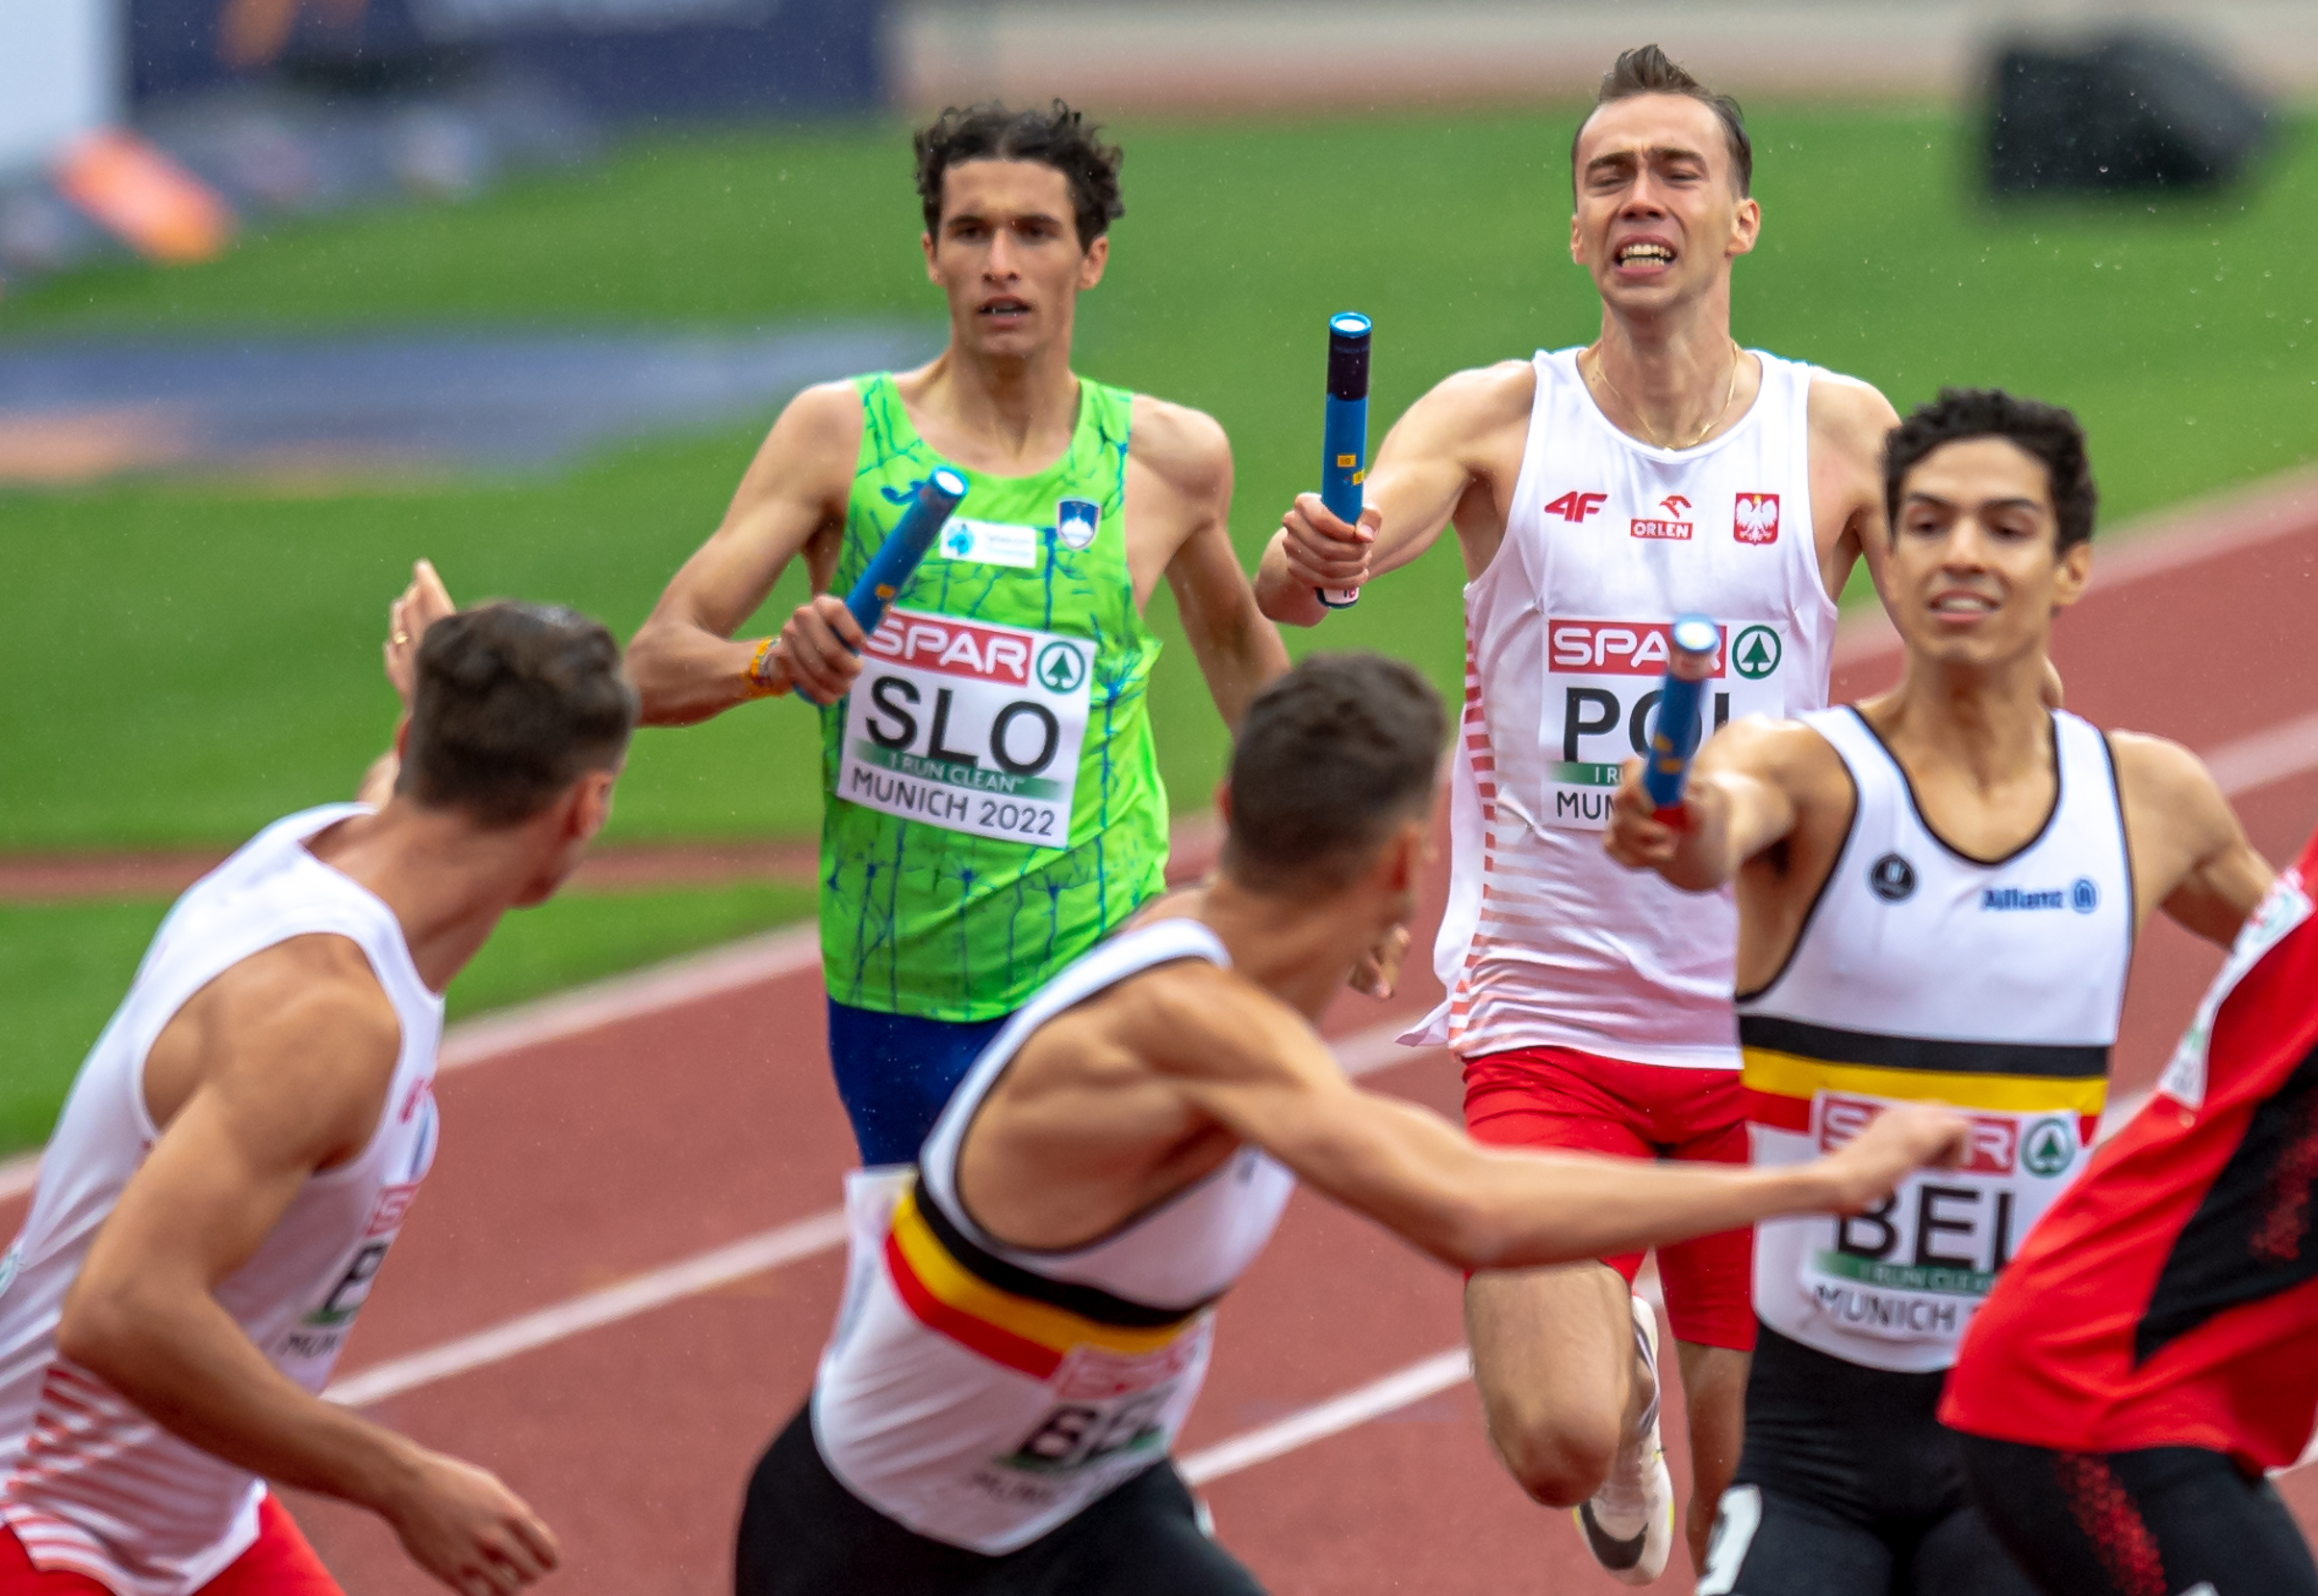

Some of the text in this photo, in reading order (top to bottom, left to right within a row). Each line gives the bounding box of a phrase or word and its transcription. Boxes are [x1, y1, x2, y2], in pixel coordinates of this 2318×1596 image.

[1544, 491, 1609, 523] 4F
[1634, 521, 1690, 539] ORLEN
[867, 619, 1029, 680] SPAR
[1553, 626, 1720, 671] SPA
[865, 675, 1059, 777] SLO
[889, 752, 898, 769] I
[902, 755, 946, 781] RUN
[852, 766, 1056, 837] MUNICH 2022
[1557, 790, 1616, 821] MUN
[1816, 1283, 1957, 1332] MUNICH
